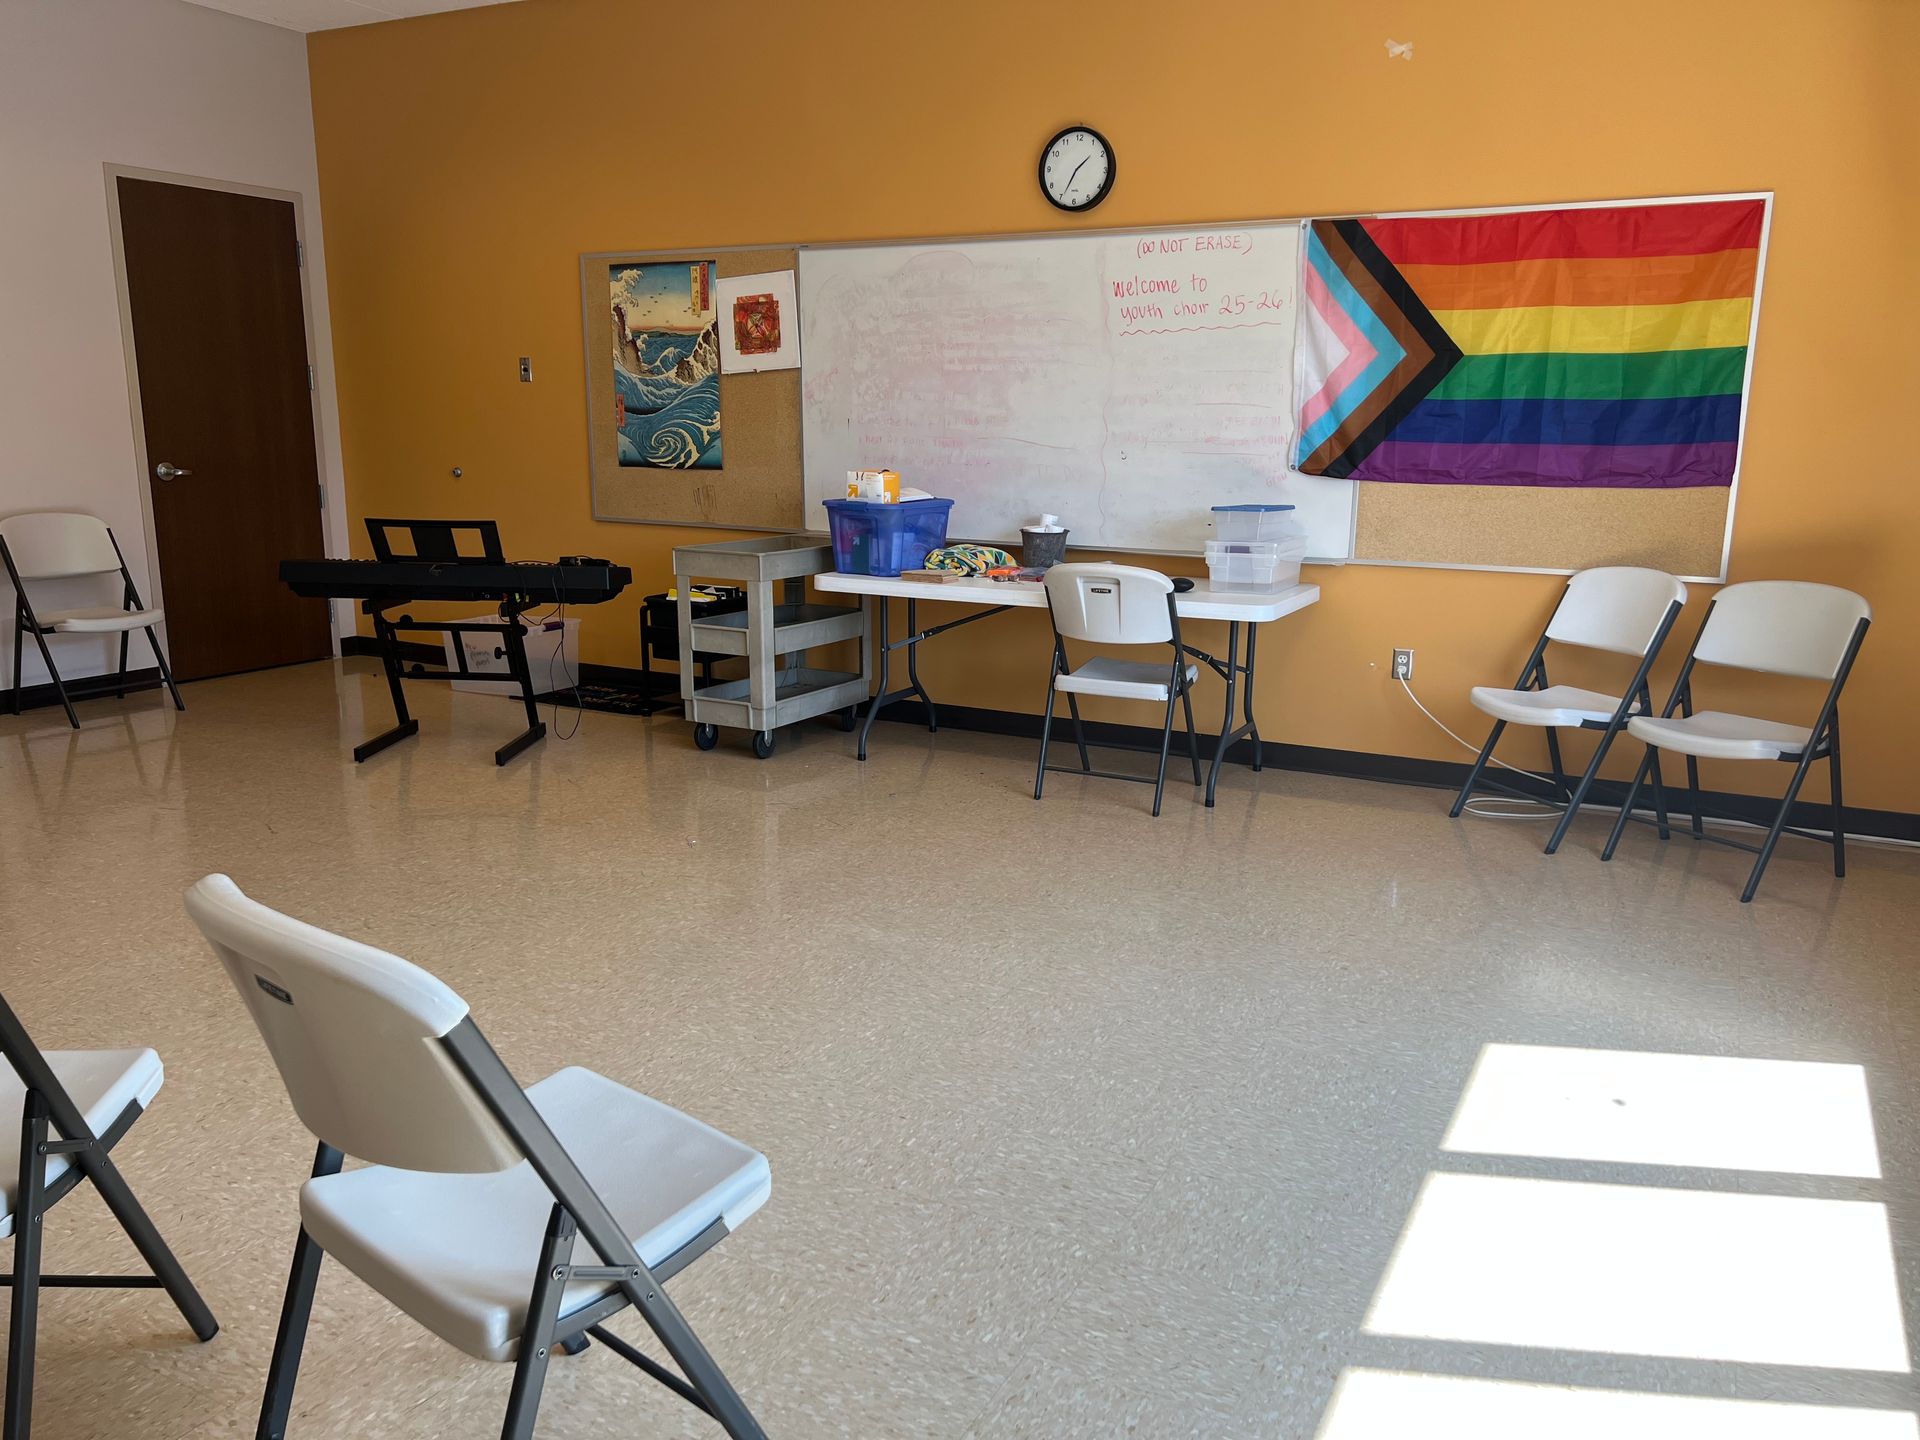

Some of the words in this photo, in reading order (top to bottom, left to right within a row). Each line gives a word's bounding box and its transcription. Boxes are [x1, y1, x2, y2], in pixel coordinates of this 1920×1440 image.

[1136, 238, 1155, 259] (DO
[1159, 237, 1189, 254] NOT
[1195, 231, 1253, 256] ERASE)
[1190, 273, 1208, 293] to
[1120, 303, 1163, 327] youth
[1173, 302, 1209, 316] choir
